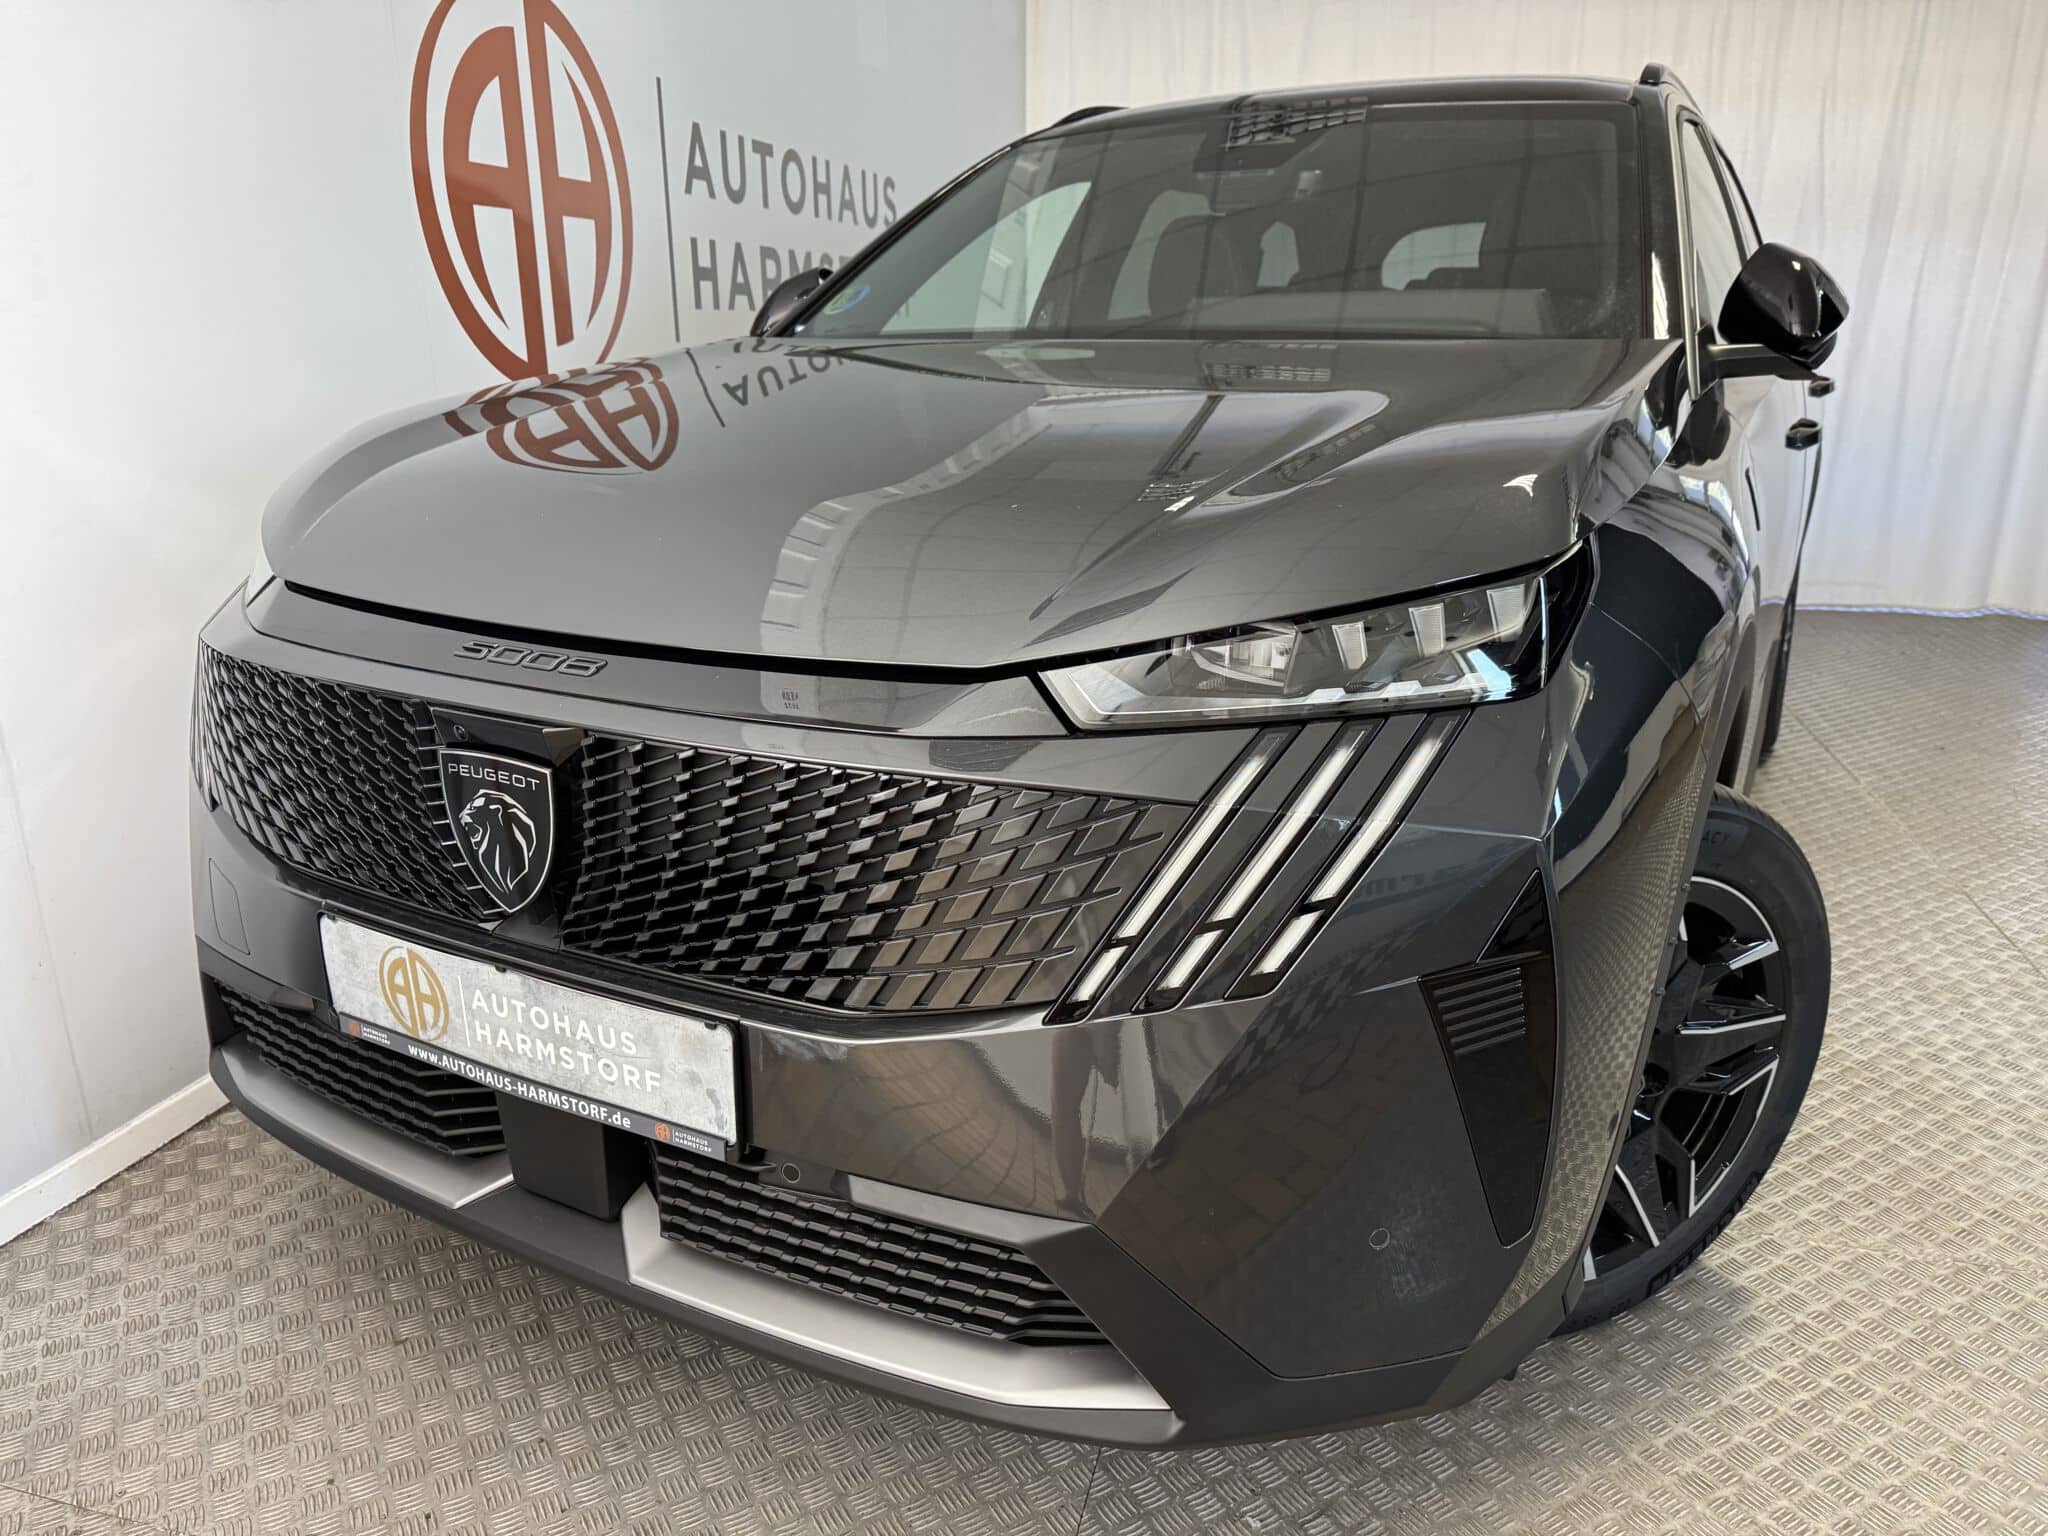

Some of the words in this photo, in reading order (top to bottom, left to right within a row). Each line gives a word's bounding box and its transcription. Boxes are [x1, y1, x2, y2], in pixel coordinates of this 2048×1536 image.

[684, 121, 898, 230] AUTOHAUS
[453, 640, 608, 678] 5008
[447, 763, 540, 791] PEUGEOT
[471, 989, 637, 1055] AUTOHAUS
[407, 1044, 632, 1129] www.AUTOHAUS-HARMSTORF.de
[474, 1019, 661, 1093] HARMSTORF
[674, 1130, 709, 1147] AUTOHAUS
